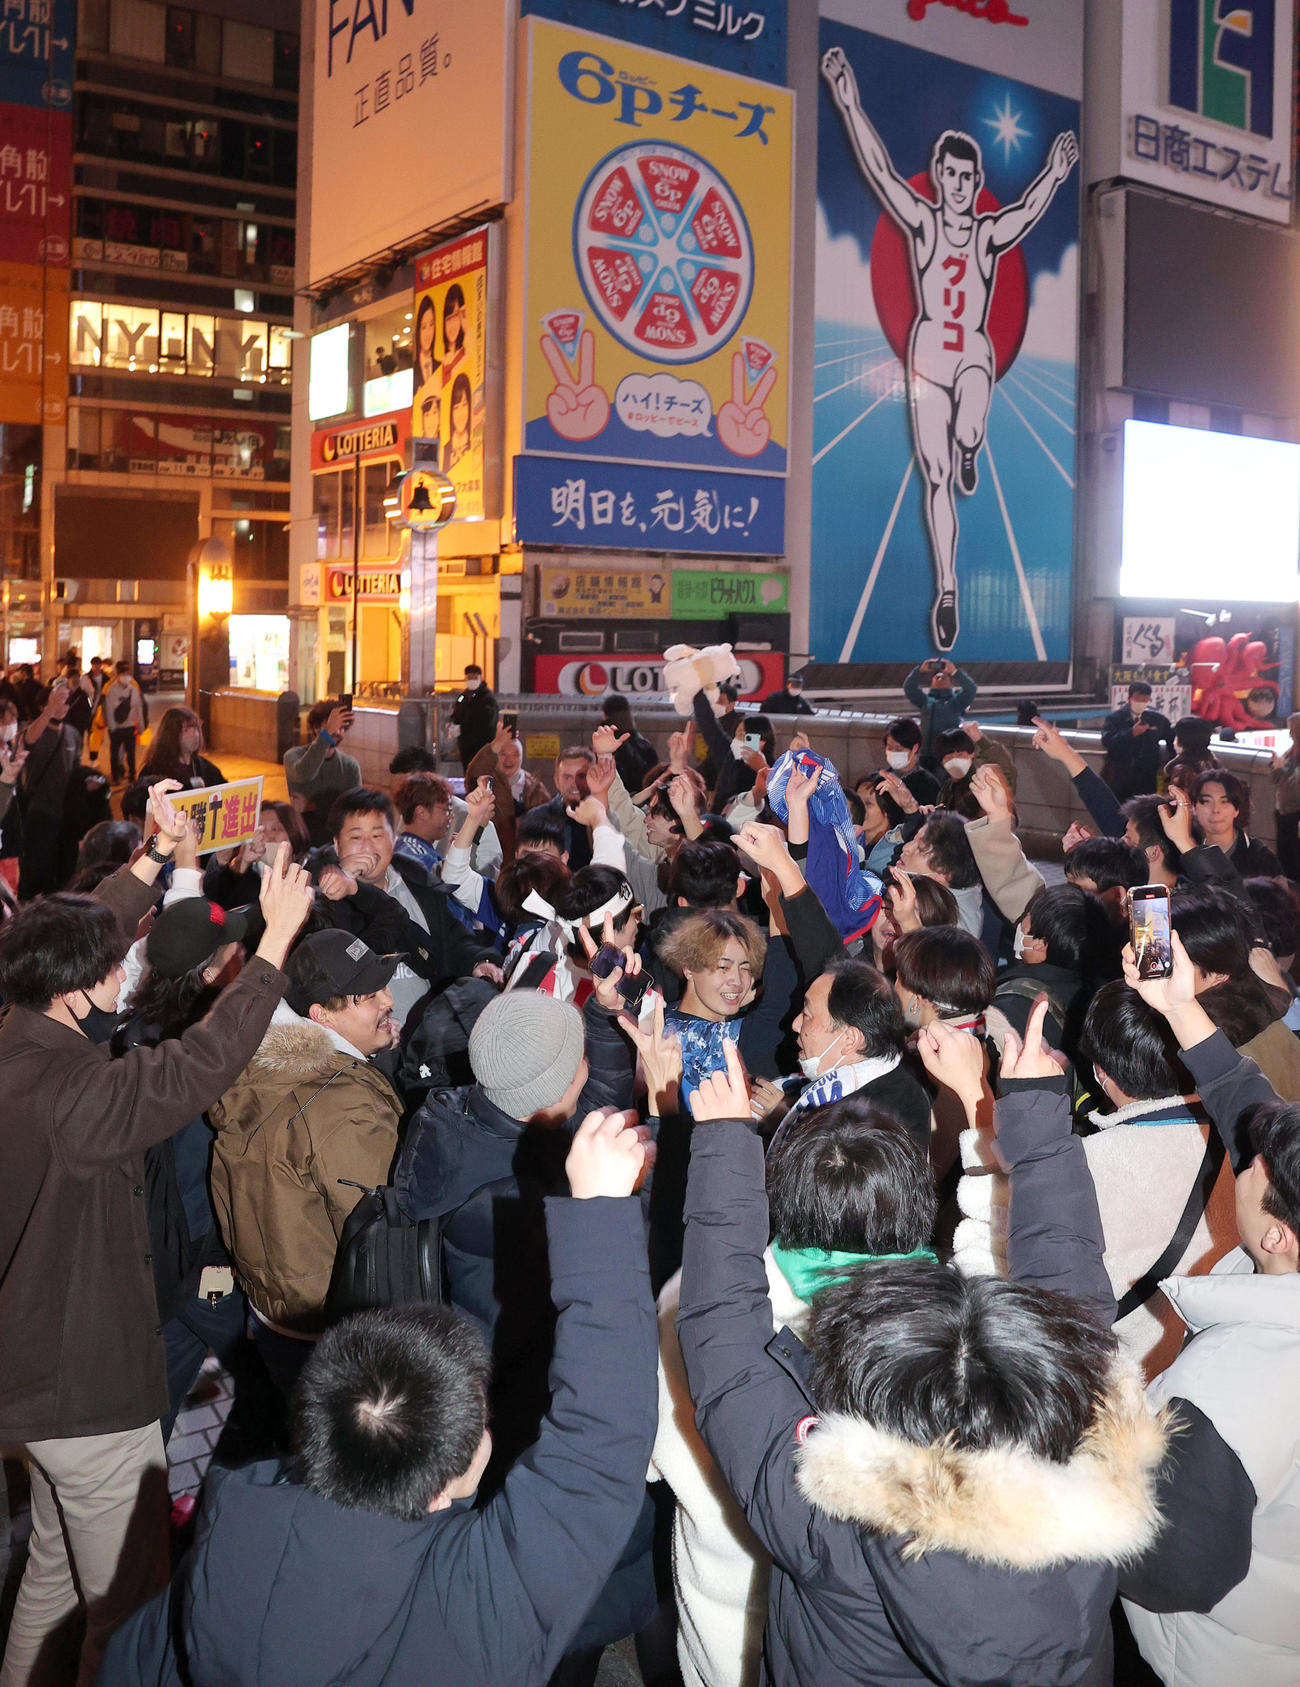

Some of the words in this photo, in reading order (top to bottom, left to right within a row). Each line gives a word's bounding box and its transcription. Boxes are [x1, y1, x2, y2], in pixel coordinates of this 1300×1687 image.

[942, 252, 969, 353] グリコ
[336, 424, 394, 455] LOTTERIA
[180, 791, 259, 846] 勝T進出
